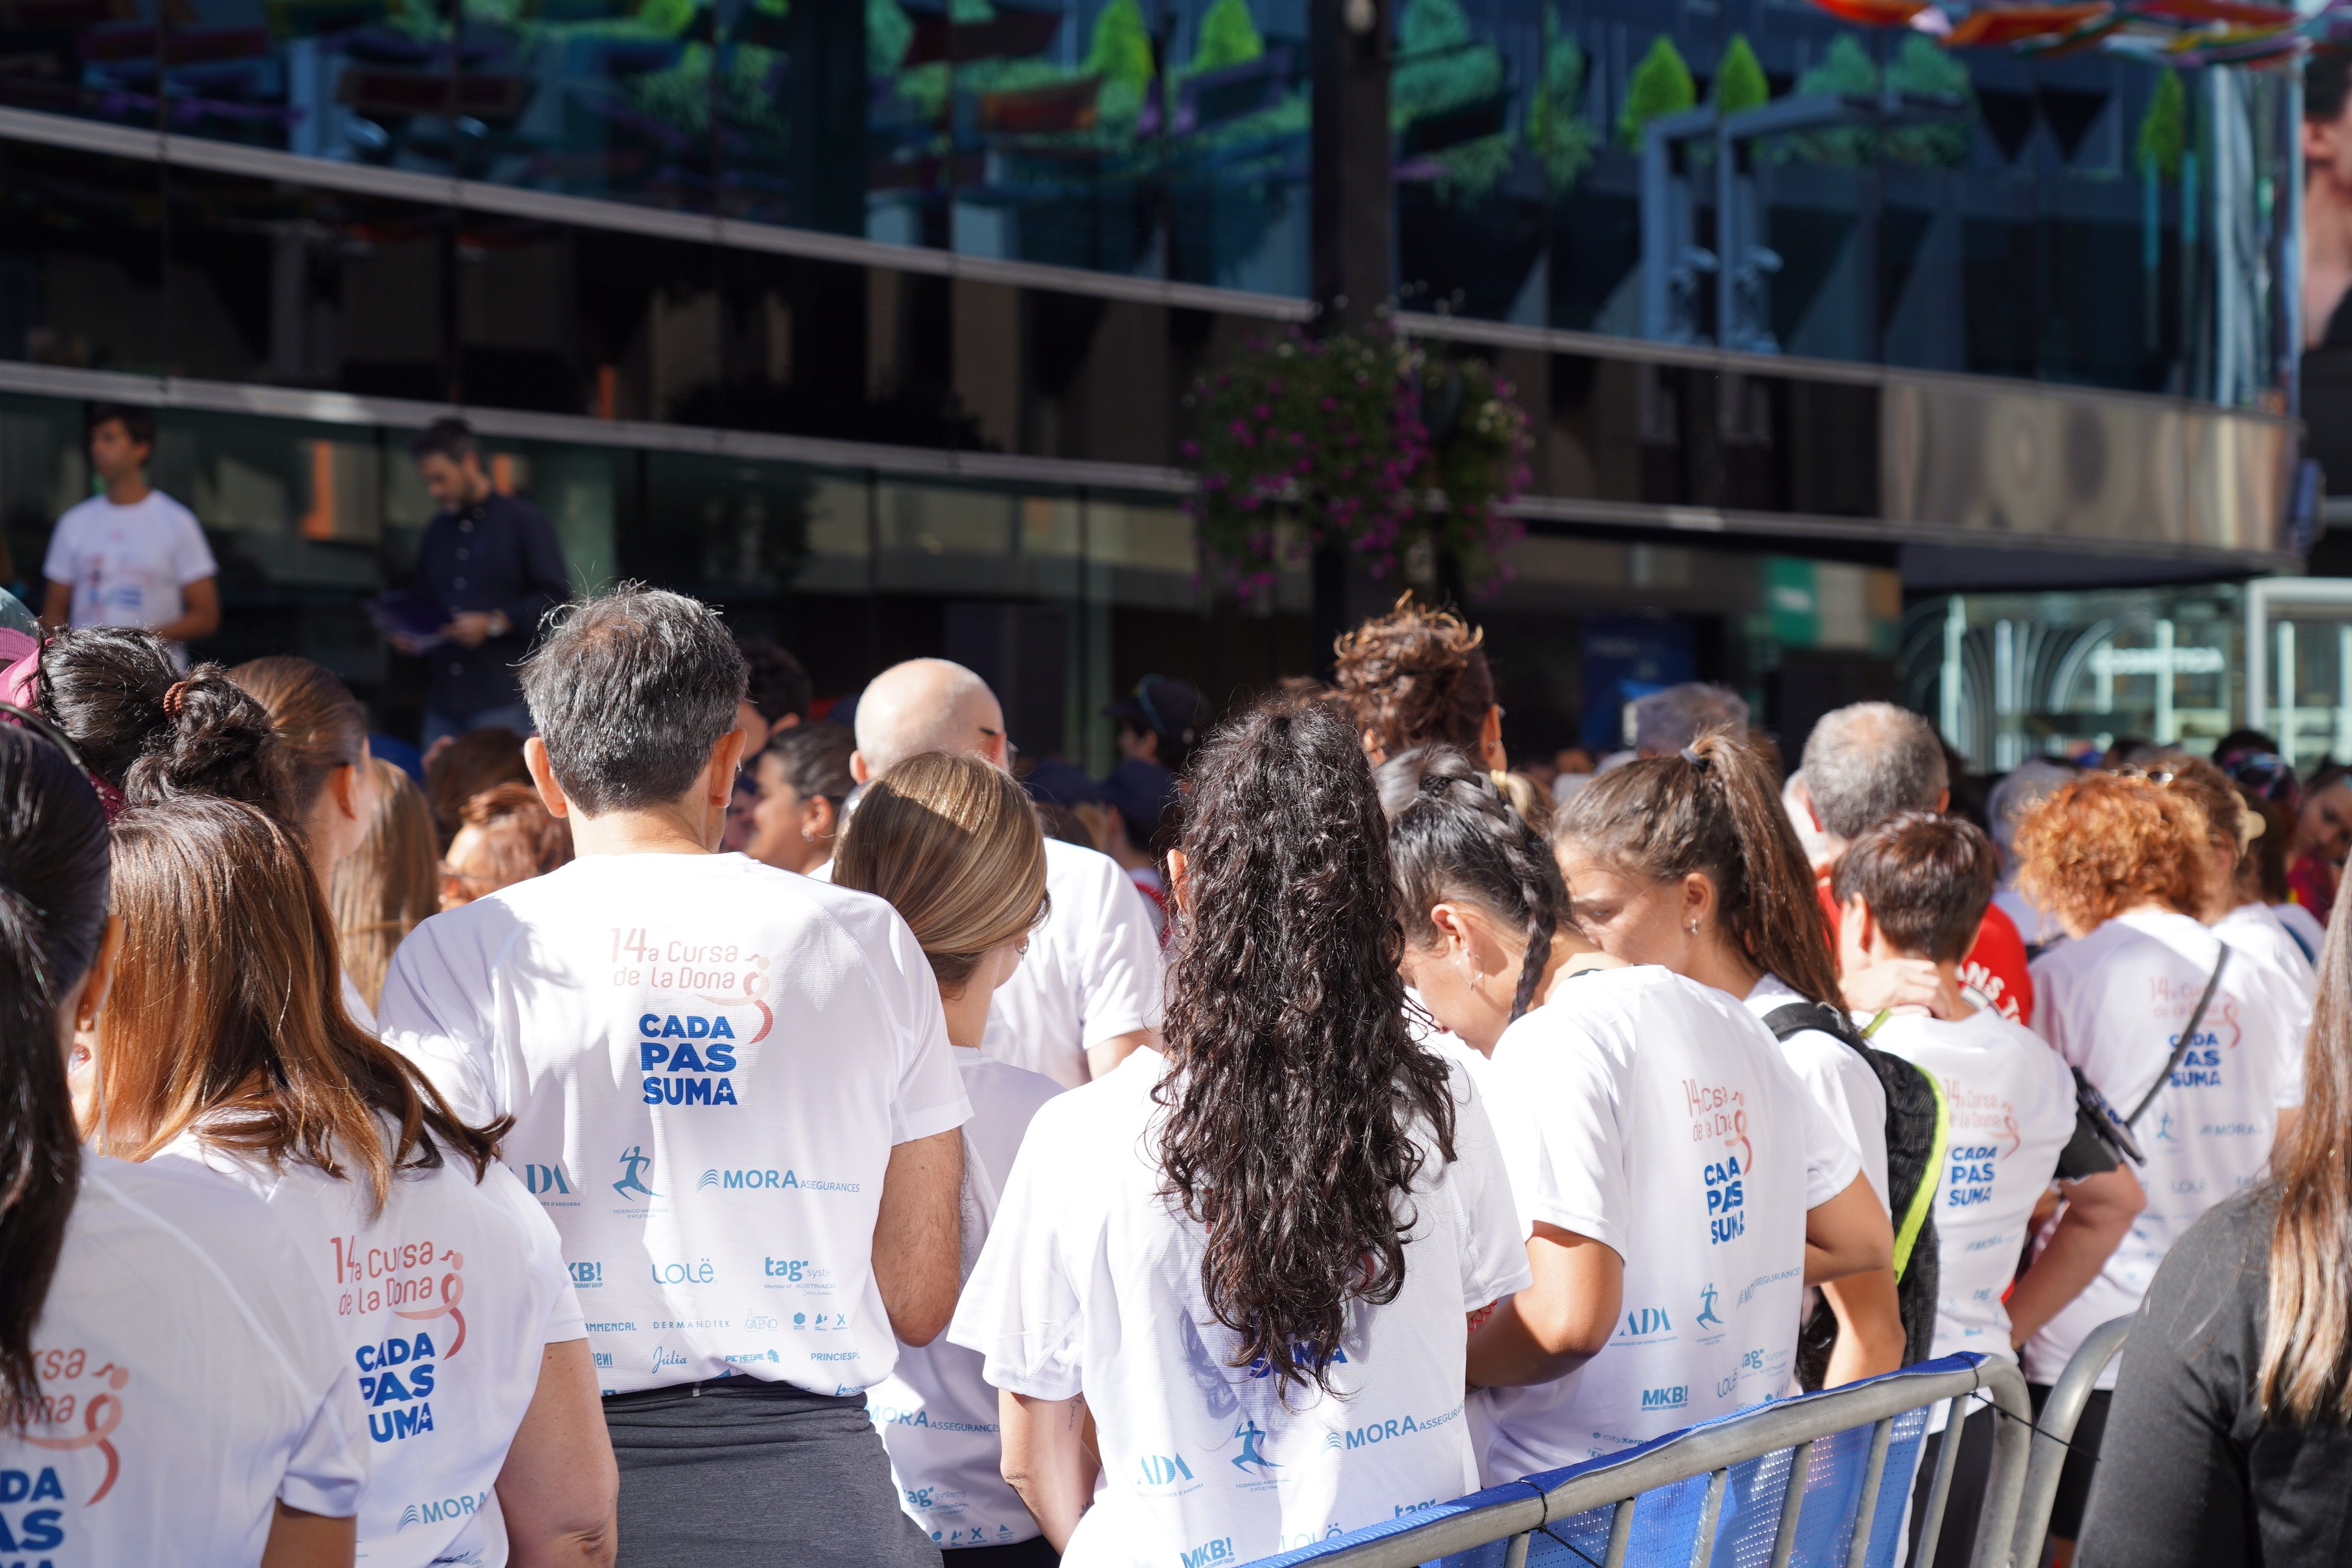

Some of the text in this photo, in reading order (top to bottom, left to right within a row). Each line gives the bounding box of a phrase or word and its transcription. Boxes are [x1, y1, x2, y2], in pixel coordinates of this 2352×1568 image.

[667, 941, 738, 963] Cursa
[614, 966, 735, 989] de la Dona
[639, 1014, 735, 1039] CADA
[2169, 1032, 2219, 1048] CDA
[641, 1042, 737, 1073] PAS
[643, 1077, 738, 1105] SUMA
[1952, 1146, 1997, 1161] CADA
[724, 1169, 860, 1193] MORA ASSEGURANCES
[1951, 1163, 1995, 1184] PAS
[1707, 1180, 1744, 1216] PAS
[1949, 1187, 1991, 1206] SUMA
[368, 1241, 433, 1278] Cursa
[568, 1262, 602, 1282] KB!
[359, 1288, 380, 1314] la
[386, 1276, 433, 1307] Dona
[654, 1321, 731, 1329] DERMANDTEK
[1619, 1306, 1672, 1336] ADA
[356, 1332, 435, 1373] CADA
[652, 1346, 688, 1374] Júlia
[358, 1364, 434, 1407] PAS
[1642, 1386, 1688, 1406] MKB!
[368, 1402, 434, 1444] UMA
[1345, 1415, 1418, 1450] MORA
[1137, 1452, 1195, 1485] ADA
[1178, 1483, 1204, 1496] D'ANDORRA
[1180, 1536, 1234, 1568] MKB!
